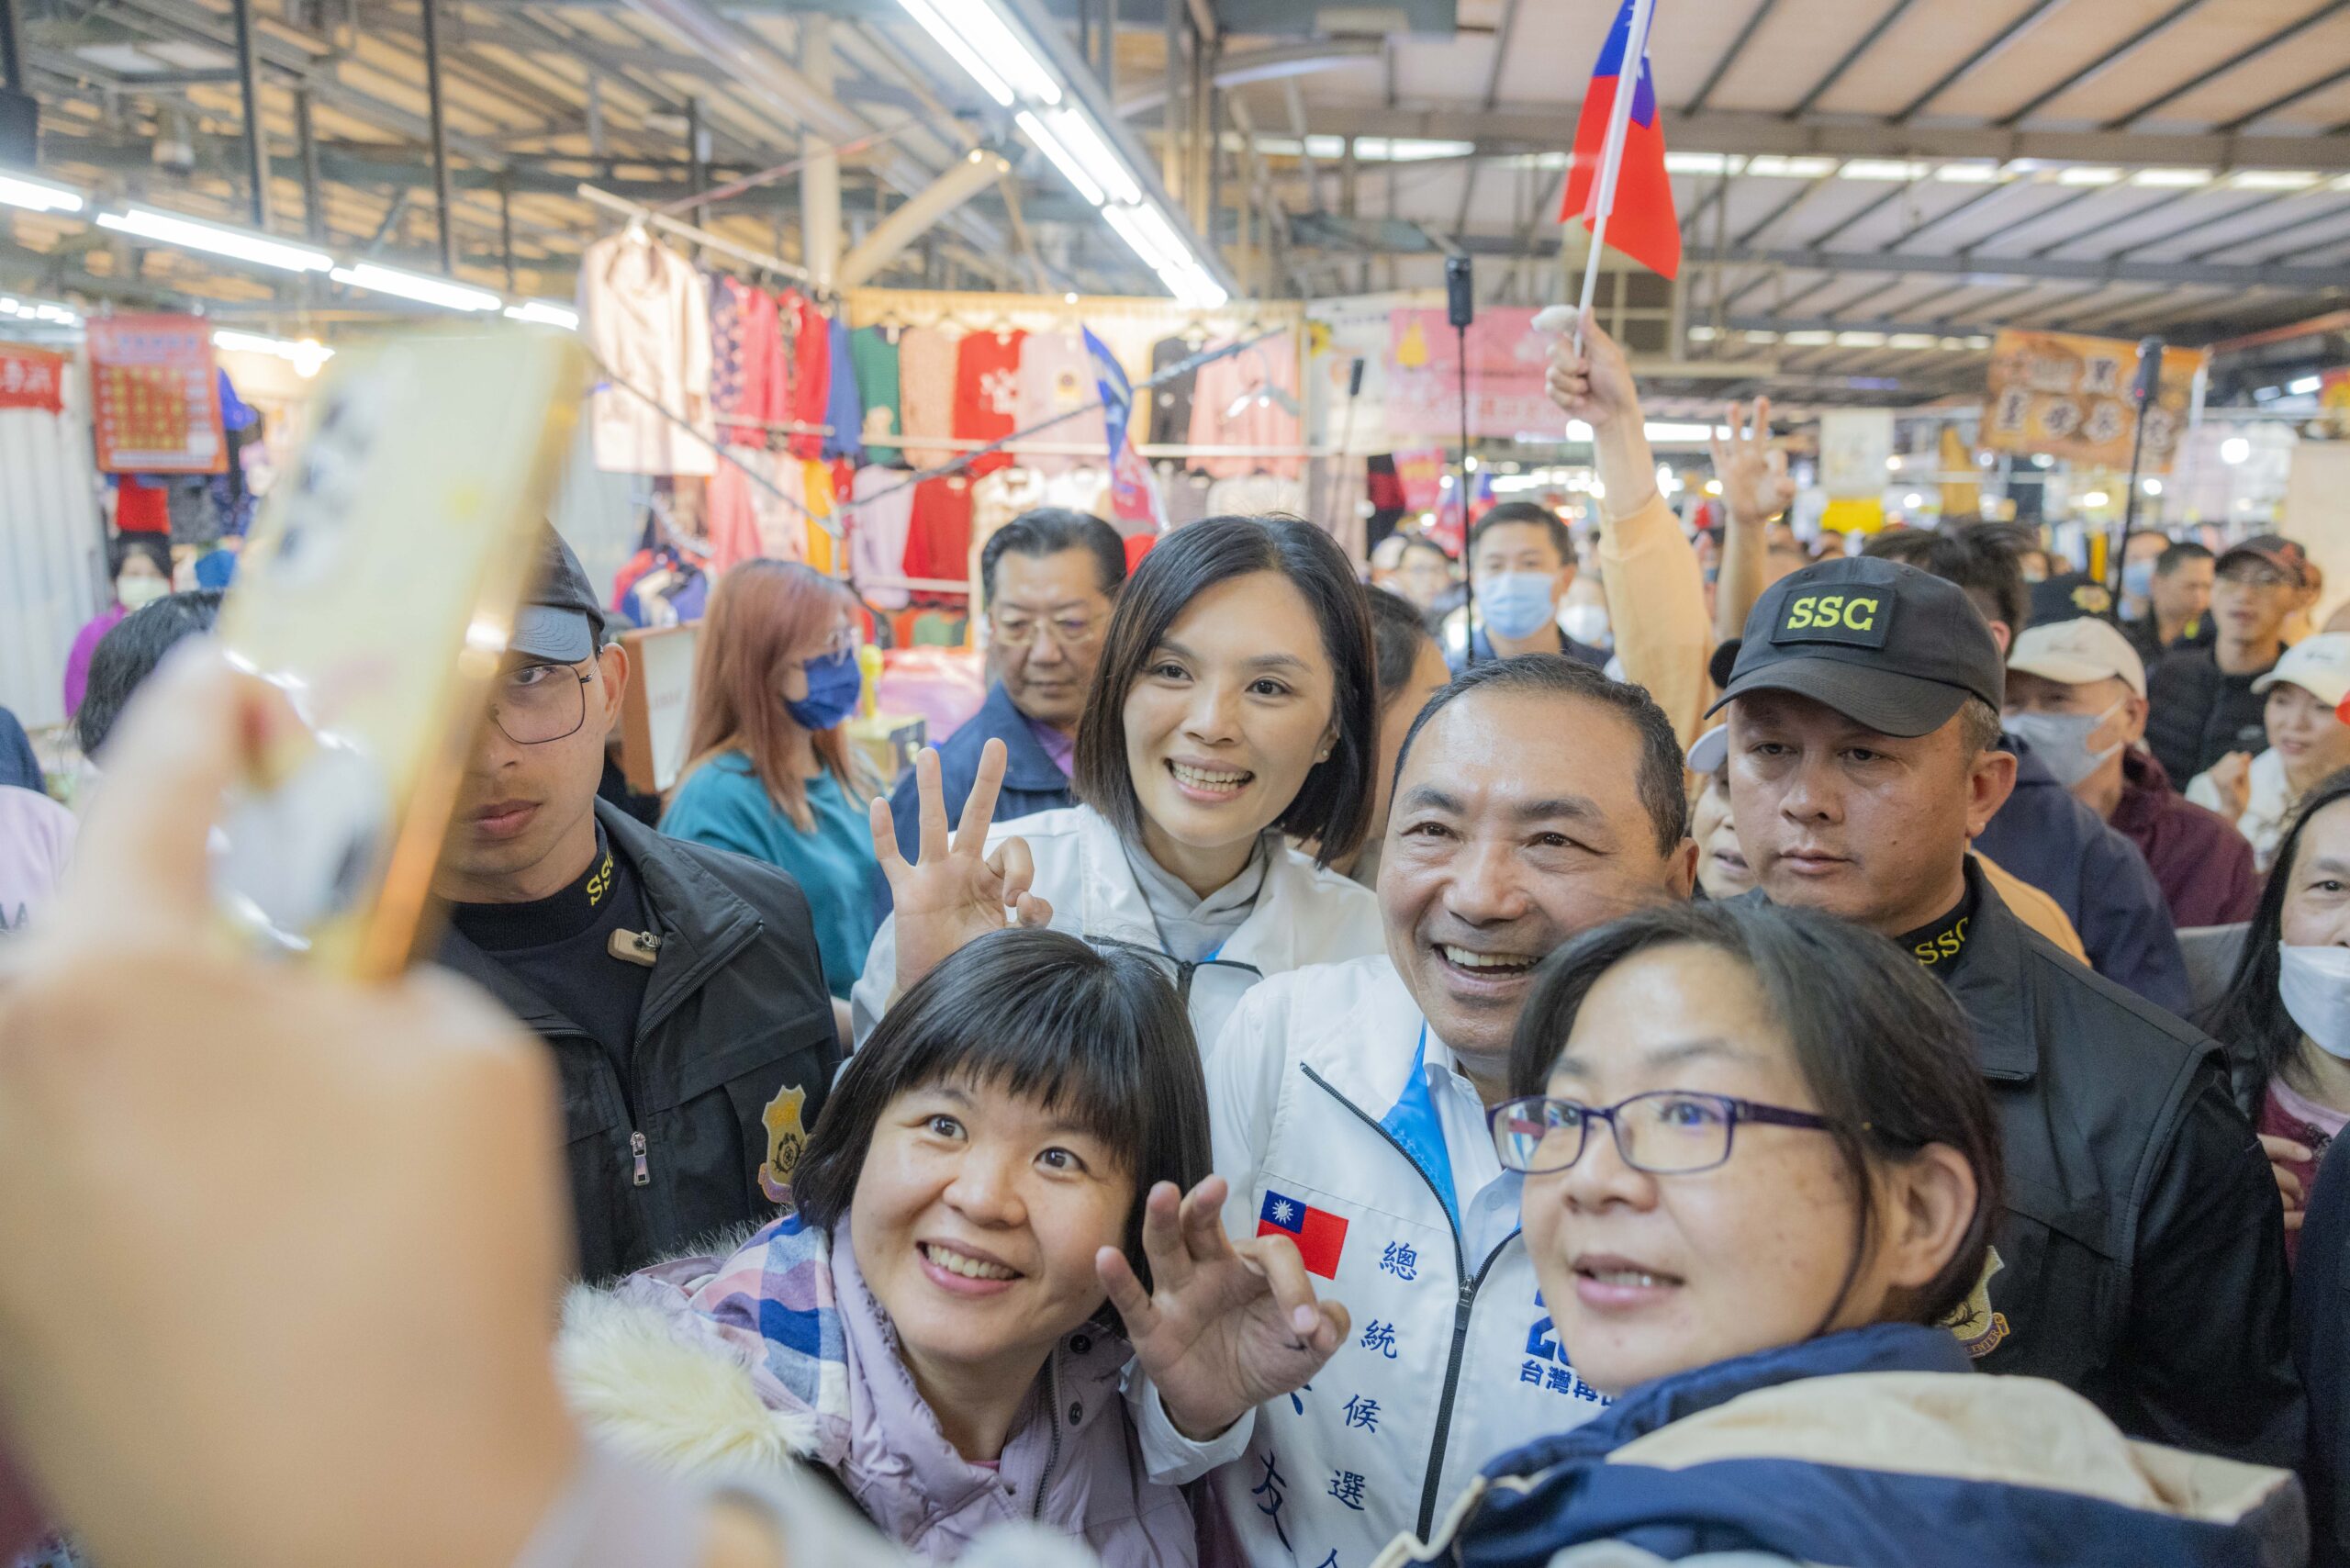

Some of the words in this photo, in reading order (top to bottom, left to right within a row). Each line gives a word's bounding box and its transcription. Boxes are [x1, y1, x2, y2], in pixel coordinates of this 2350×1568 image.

[1786, 596, 1879, 631] SSC
[1520, 1359, 1614, 1406] 台灣再
